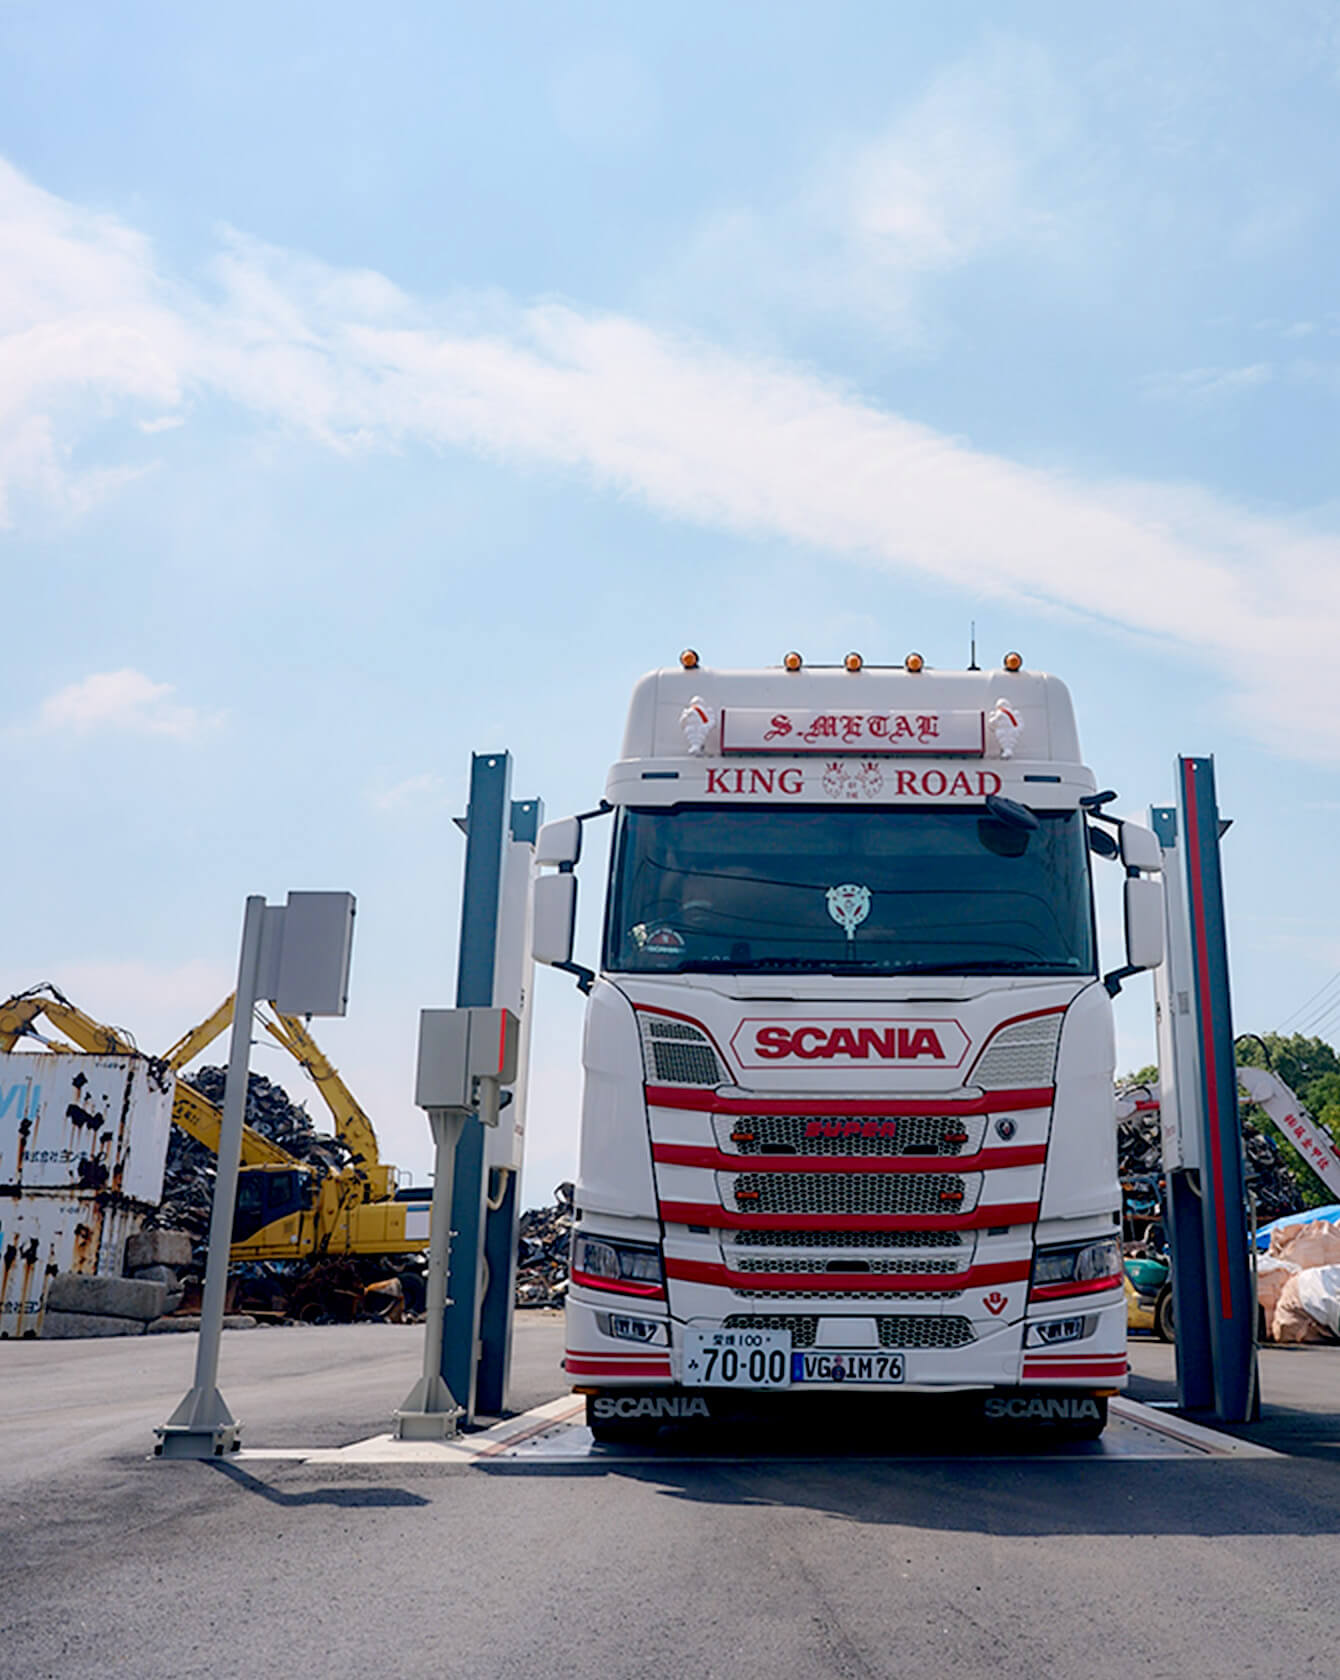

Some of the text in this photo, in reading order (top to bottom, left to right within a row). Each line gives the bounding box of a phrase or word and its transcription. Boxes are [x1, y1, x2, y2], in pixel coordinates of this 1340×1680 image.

[763, 714, 941, 744] S.METAL
[705, 767, 1003, 797] KING ROAD
[754, 1026, 947, 1060] SCANIA
[739, 1334, 763, 1347] 100
[702, 1348, 786, 1383] 70-00
[804, 1356, 902, 1380] VG IM 76
[593, 1397, 711, 1419] SCANIA
[984, 1398, 1101, 1419] SCANIA
